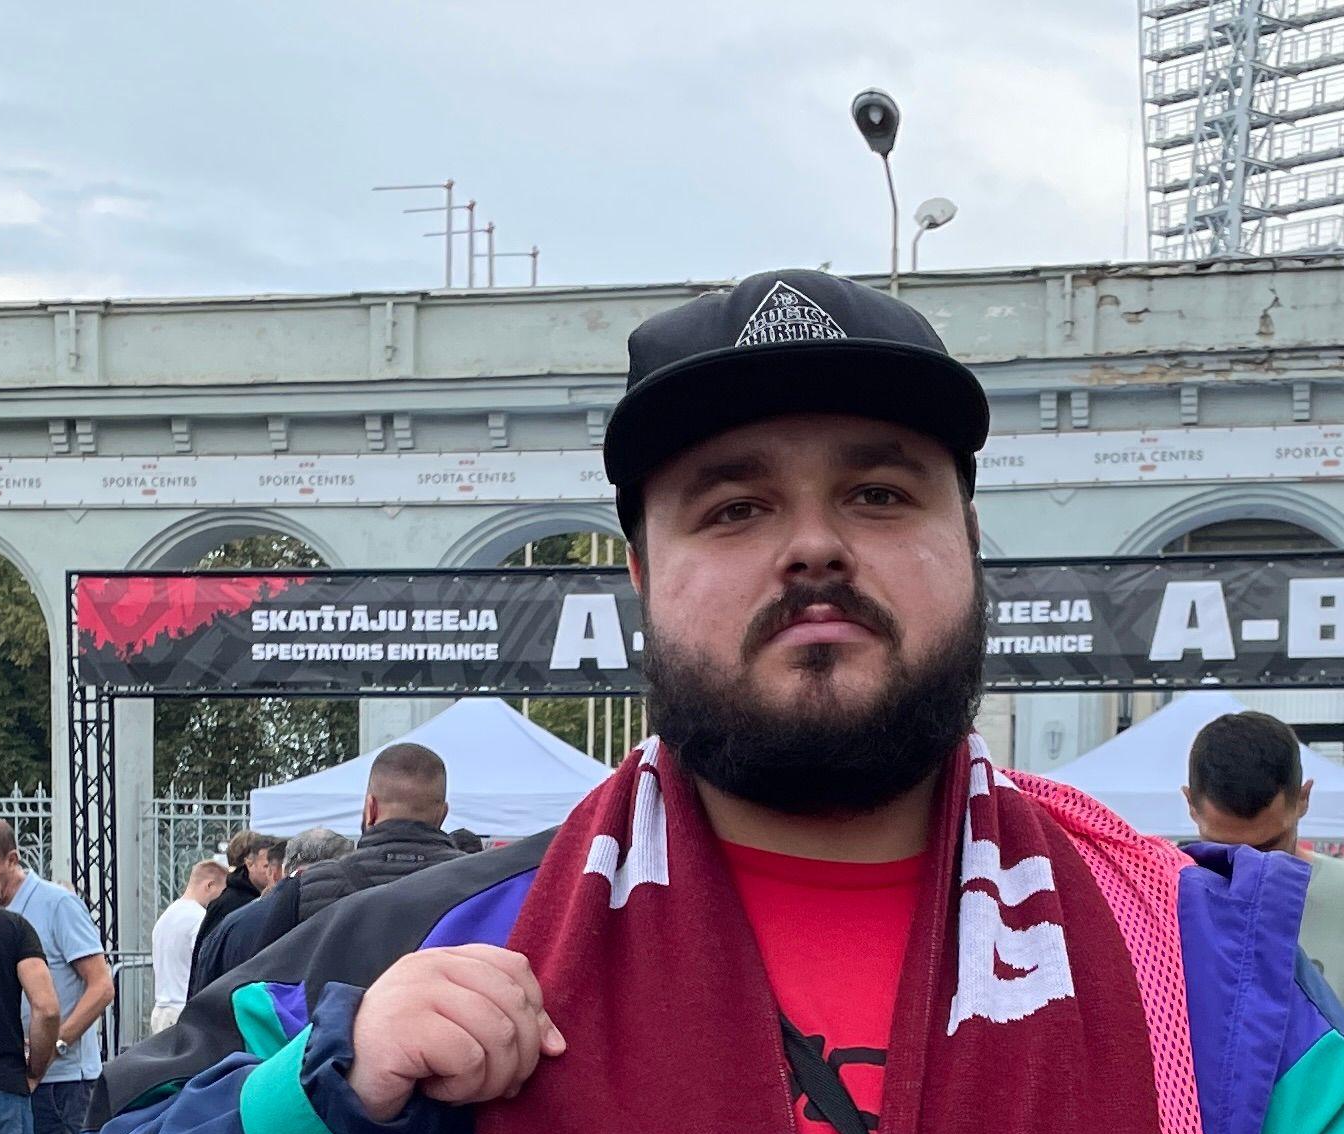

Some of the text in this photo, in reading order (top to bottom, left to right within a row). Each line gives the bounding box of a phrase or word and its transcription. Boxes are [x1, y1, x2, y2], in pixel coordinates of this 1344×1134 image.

[1094, 450, 1204, 464] SPORTA CENTRS
[1275, 446, 1328, 459] SPORTA
[102, 476, 198, 488] SPORTA CENTRS
[258, 474, 355, 486] SPORTA CENTRS
[417, 472, 516, 485] SPORTA CENTRS
[580, 471, 605, 482] SPO
[251, 604, 499, 632] SKATĪTĀJU IEEJA
[998, 599, 1093, 624] IEEJA
[985, 634, 1094, 655] NTRANCE
[251, 642, 499, 662] SPECTATORS ENTRANCE
